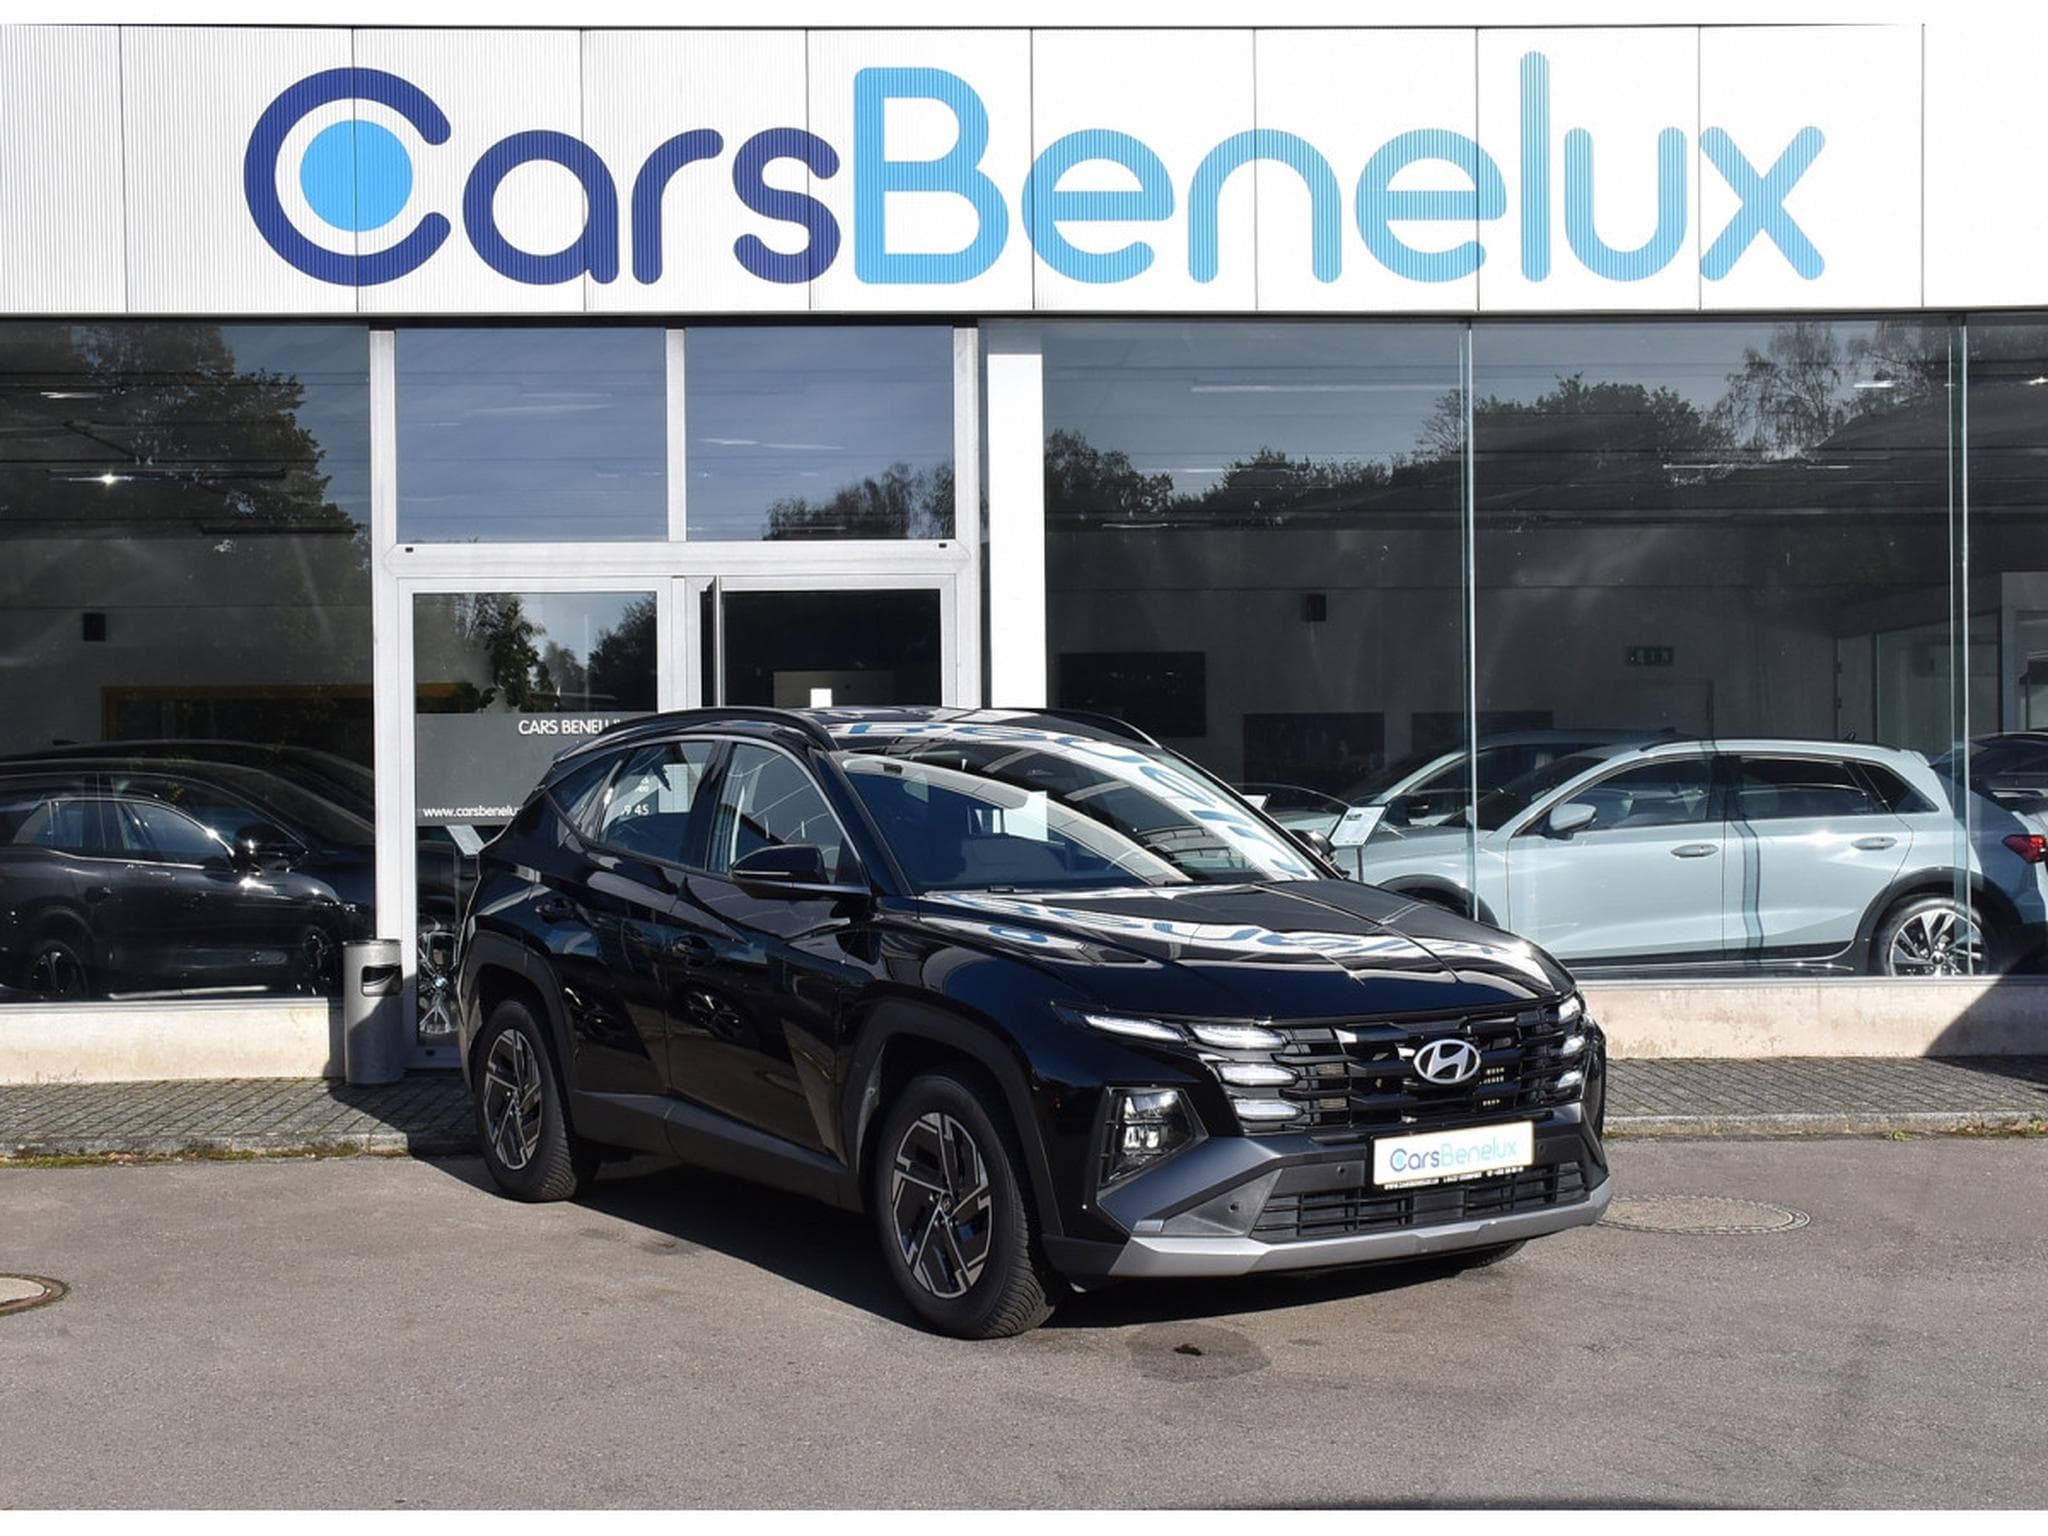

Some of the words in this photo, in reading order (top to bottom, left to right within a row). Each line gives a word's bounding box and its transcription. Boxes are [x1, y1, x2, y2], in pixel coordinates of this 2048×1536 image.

[244, 51, 1825, 286] CarsBenelux
[518, 719, 559, 735] CARS
[634, 803, 650, 816] 45
[1390, 1136, 1518, 1173] CarsBenelux
